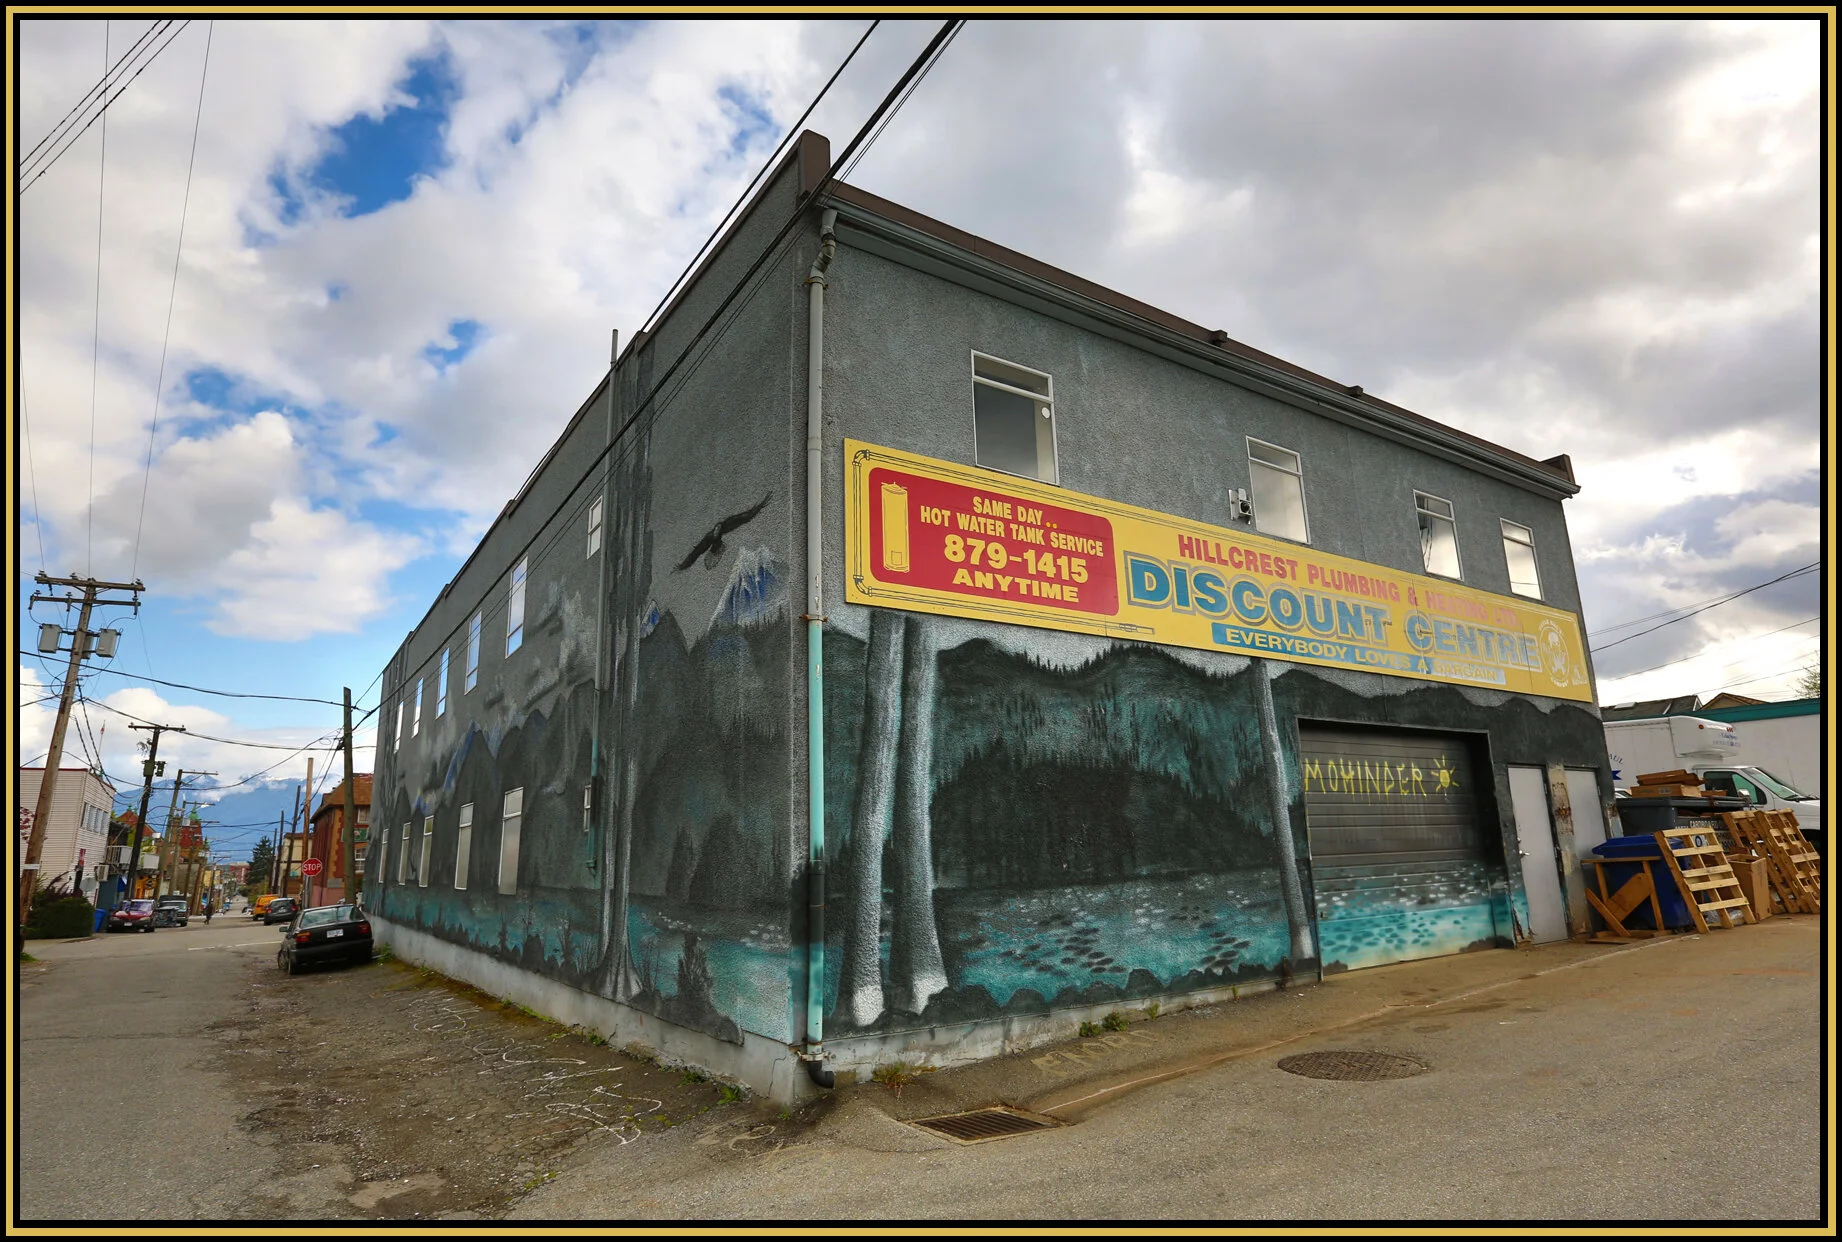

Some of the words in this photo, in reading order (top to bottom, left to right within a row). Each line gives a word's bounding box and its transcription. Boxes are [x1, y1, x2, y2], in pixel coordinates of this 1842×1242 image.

[920, 505, 951, 527] HOT
[956, 512, 1005, 537] WATER
[1010, 523, 1045, 545] TANK
[1050, 532, 1104, 557] SERVICE
[973, 496, 1012, 519] SAME
[944, 534, 1088, 583] 879-1415
[1178, 534, 1298, 580] HILLCREST
[1307, 564, 1400, 602] PLUMBING
[1407, 586, 1418, 607] &
[1425, 590, 1488, 621] HEATING
[952, 568, 1079, 602] ANYTIME
[1125, 552, 1391, 645] DISCOUNT
[1404, 609, 1541, 671] CENTRE
[1226, 628, 1348, 659] EVERYBODY
[1355, 649, 1411, 669] LOVES
[1417, 657, 1429, 671] A
[1434, 661, 1497, 681] BARGAIN
[303, 863, 321, 872] STOP
